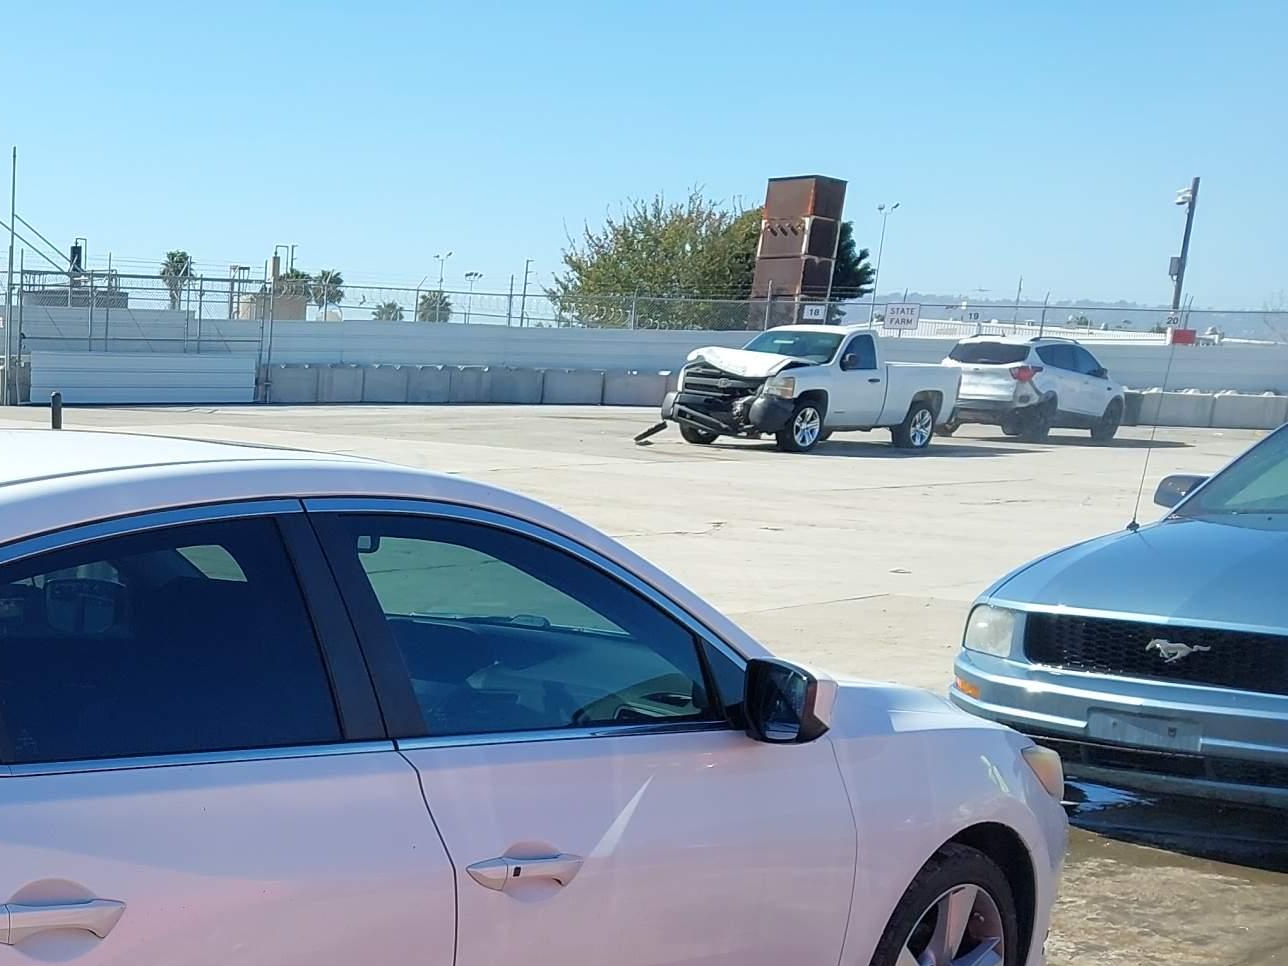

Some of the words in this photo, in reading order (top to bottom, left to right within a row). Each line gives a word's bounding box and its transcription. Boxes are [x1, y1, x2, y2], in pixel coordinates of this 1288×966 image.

[809, 308, 820, 317] 18
[889, 307, 915, 316] STATE
[968, 312, 980, 321] 19
[1166, 316, 1179, 325] 20
[889, 317, 914, 326] FARM
